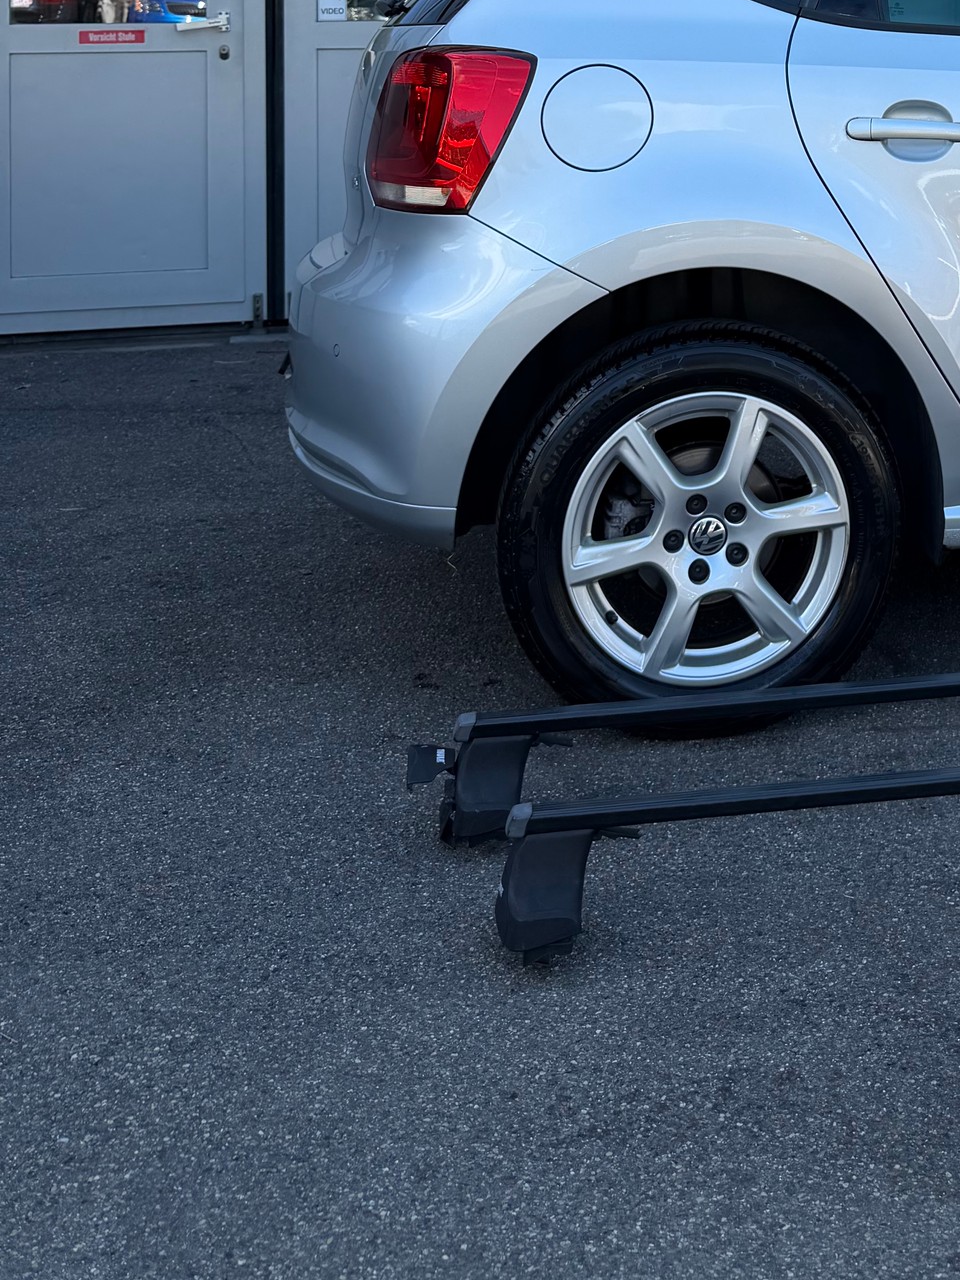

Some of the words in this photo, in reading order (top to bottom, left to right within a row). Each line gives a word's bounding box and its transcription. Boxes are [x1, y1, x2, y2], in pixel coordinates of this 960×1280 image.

[321, 7, 345, 15] VIDEO
[88, 32, 117, 42] Vorsicht
[118, 31, 136, 41] Stufe
